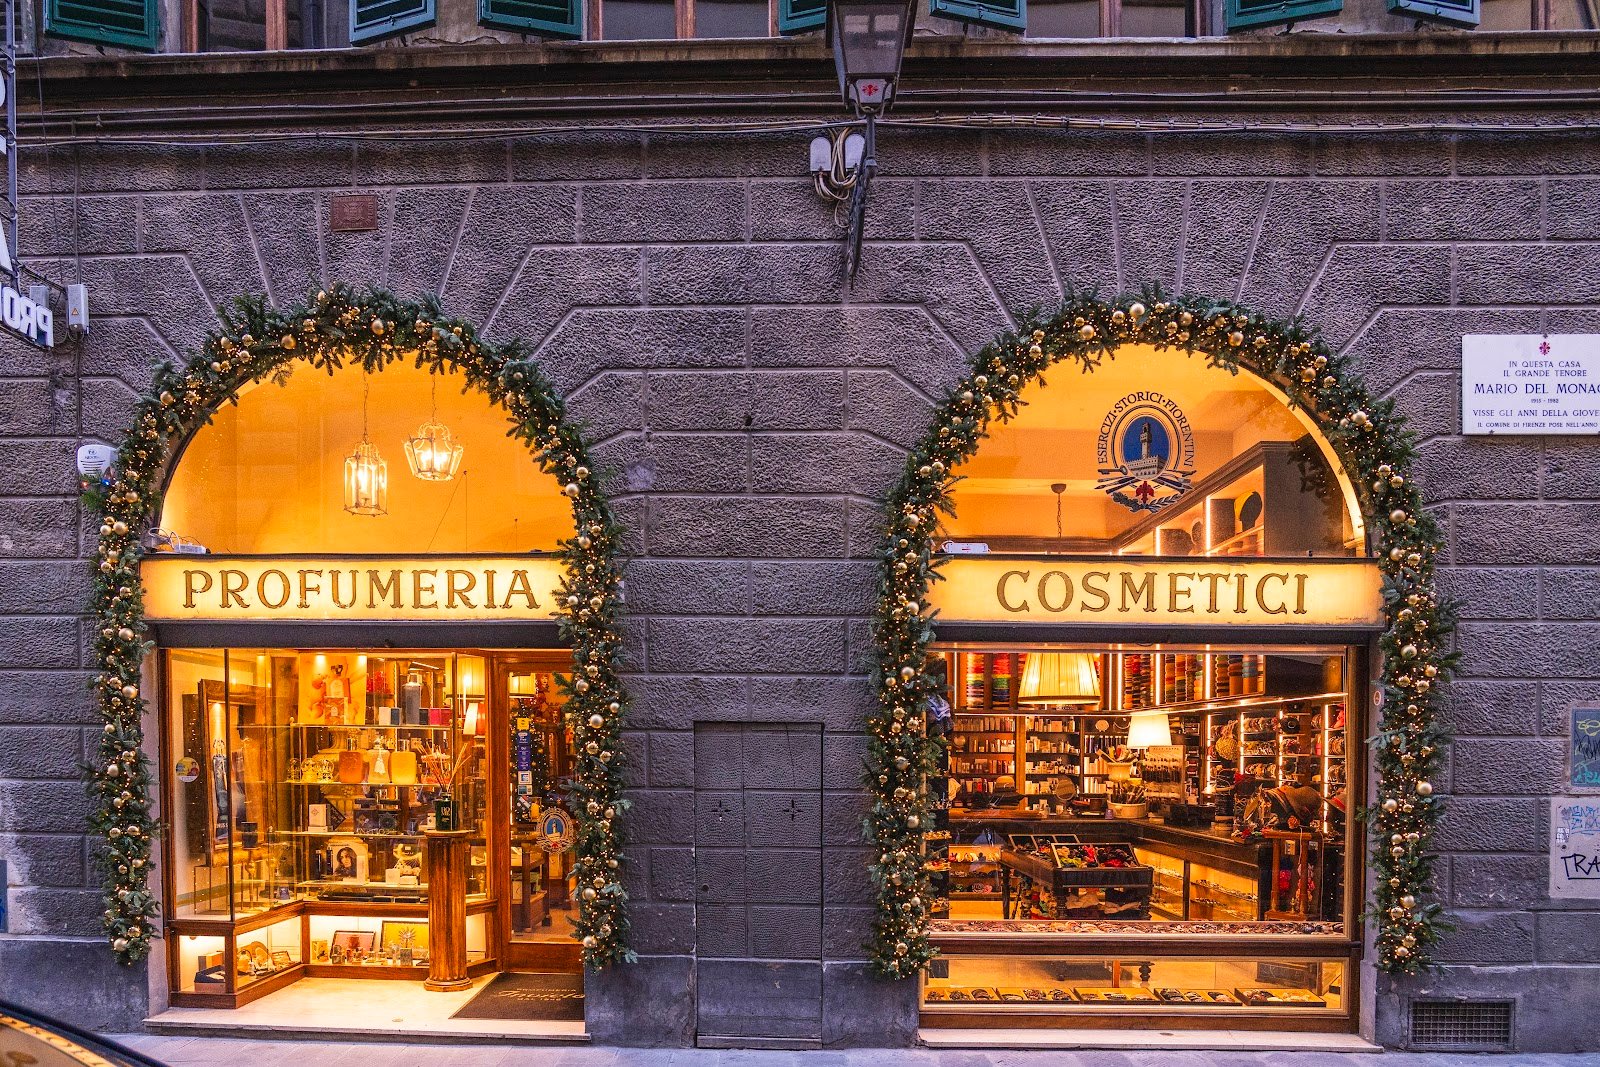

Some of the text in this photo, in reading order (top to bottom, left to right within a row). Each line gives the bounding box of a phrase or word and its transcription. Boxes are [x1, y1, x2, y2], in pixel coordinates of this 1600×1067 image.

[1521, 361, 1554, 369] QUESTA
[1474, 383, 1518, 394] MARIO
[1525, 383, 1549, 394] DEL
[1472, 409, 1495, 417] VISSE
[1499, 409, 1513, 417] GLI
[1517, 409, 1538, 417] ANNI
[1542, 409, 1568, 417] DELLA
[1097, 391, 1195, 467] ESERCIZI STORICI FIORENTINI
[183, 569, 541, 609] PROFUMERIA
[996, 570, 1309, 614] COSMETICI
